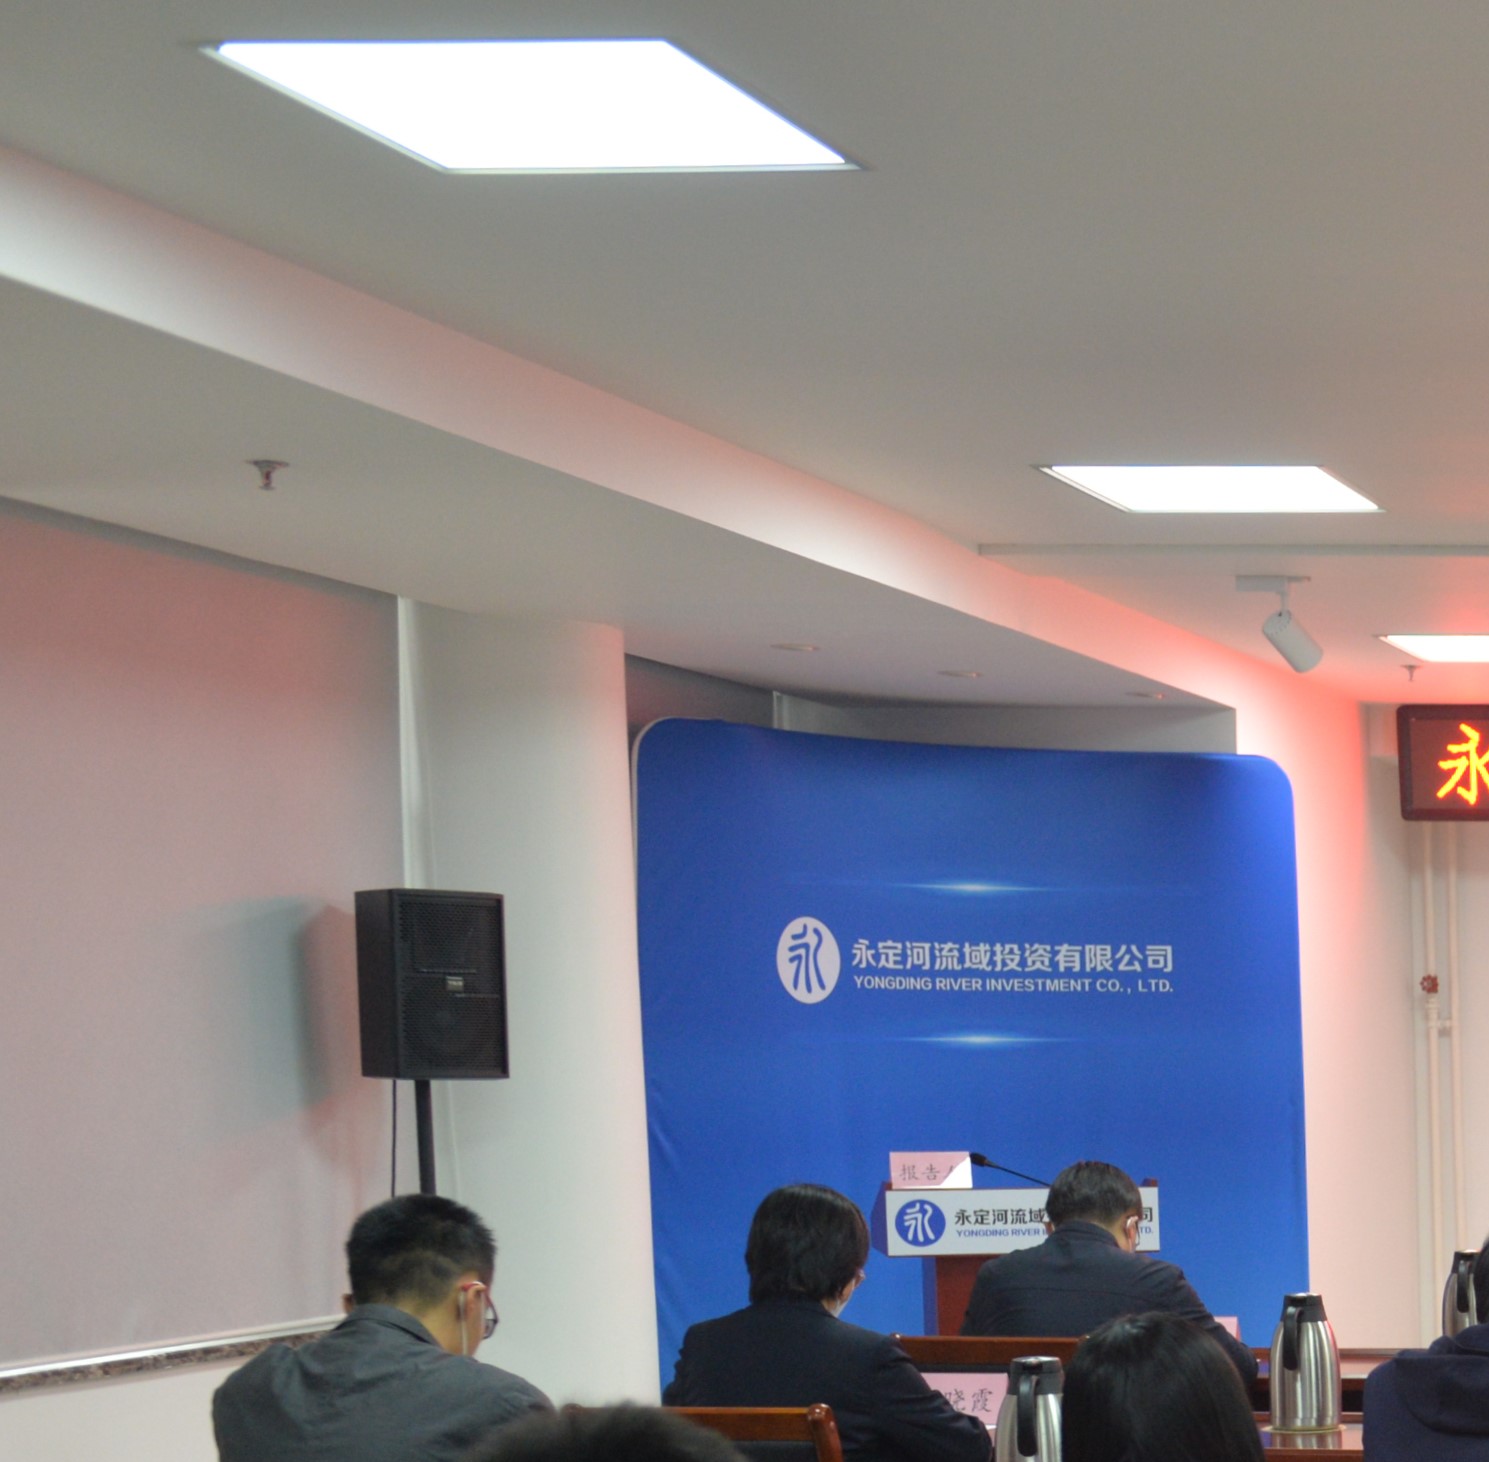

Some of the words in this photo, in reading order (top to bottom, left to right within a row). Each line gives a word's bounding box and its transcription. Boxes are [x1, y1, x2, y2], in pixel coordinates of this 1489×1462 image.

[851, 938, 1174, 973] 永定河流域投资有限公司
[853, 975, 932, 992] YONGDING
[935, 977, 983, 993] RIVER
[986, 977, 1092, 993] INVESTMENT
[1138, 979, 1174, 994] LTD.
[956, 1228, 1010, 1238] YONGDING
[1011, 1228, 1041, 1237] RIVER
[944, 1387, 993, 1413] 晓霞
